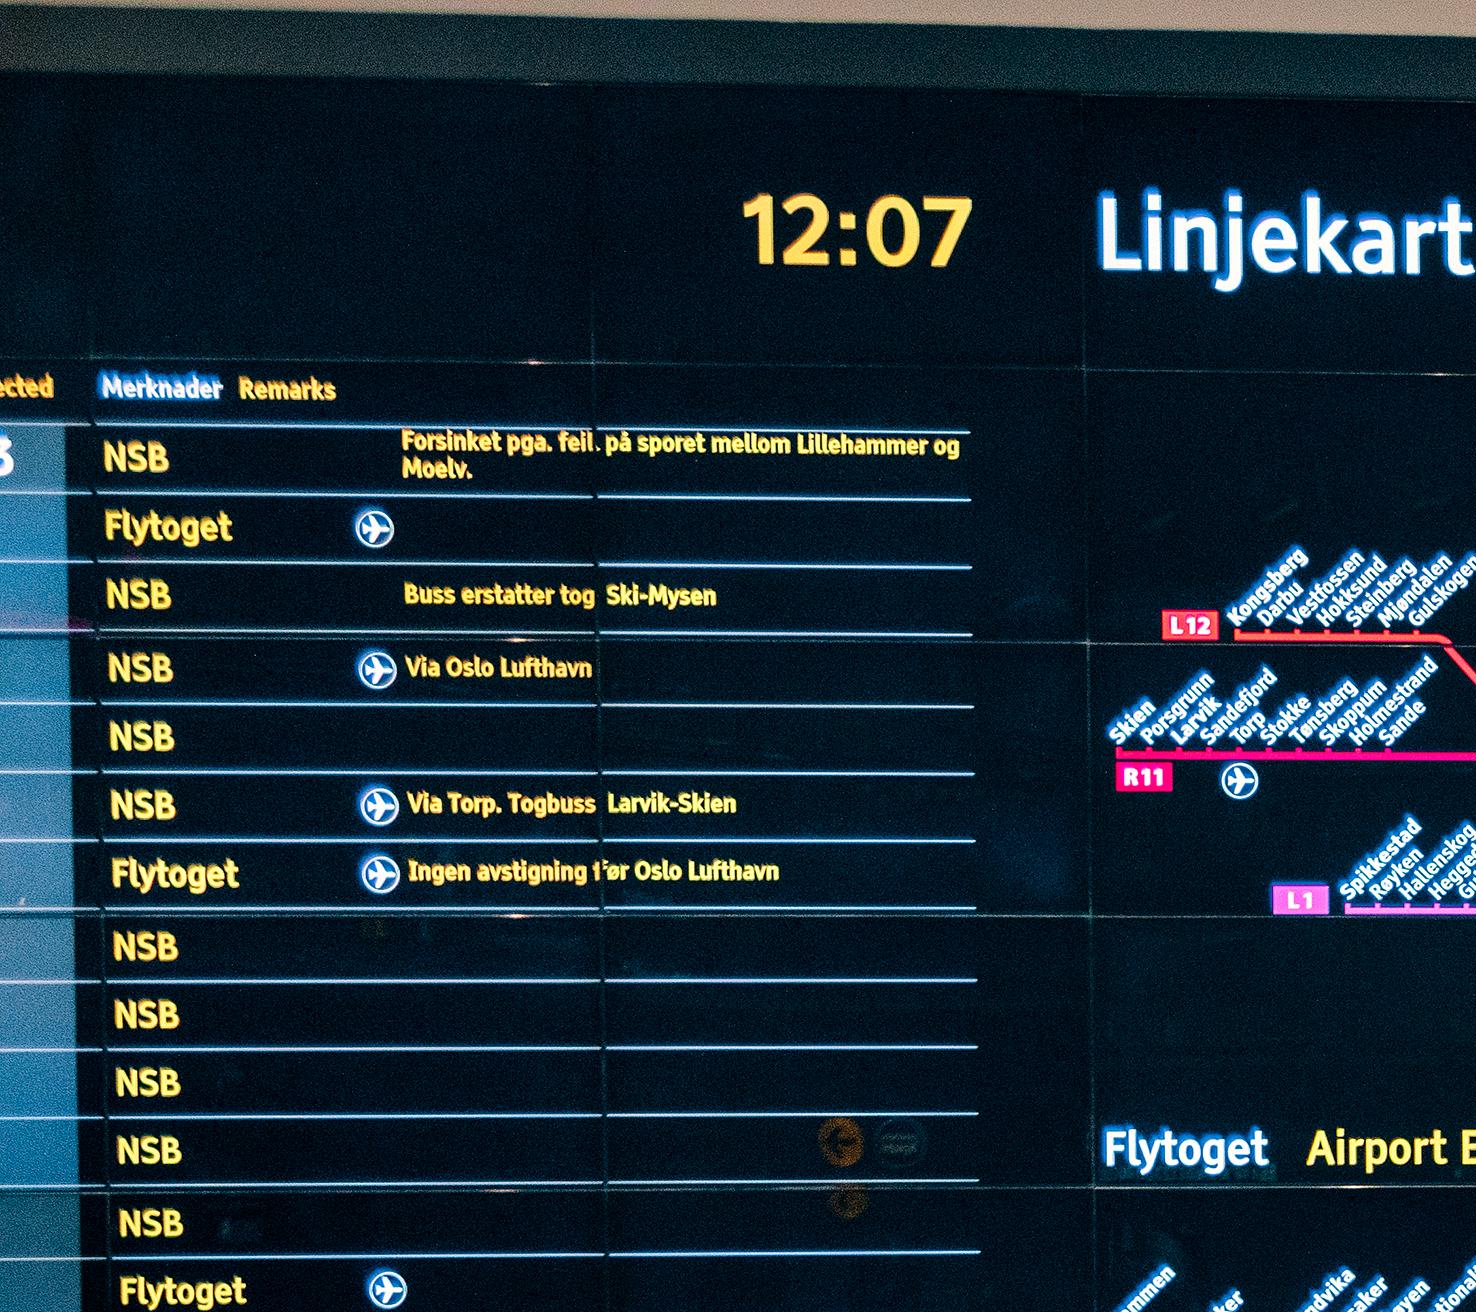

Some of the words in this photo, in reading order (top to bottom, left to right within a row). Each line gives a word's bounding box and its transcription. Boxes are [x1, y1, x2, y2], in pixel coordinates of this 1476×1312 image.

[744, 194, 972, 267] 12:07
[1102, 191, 1475, 292] Linjekart
[102, 374, 223, 399] Merknader
[239, 377, 336, 400] Remarks
[104, 441, 169, 472] NSB
[401, 429, 502, 452] Forsinket
[506, 433, 554, 457] pga.
[605, 431, 632, 456] på
[636, 432, 706, 457] sporet
[711, 433, 792, 455] mellom
[796, 432, 929, 455] Lillehammer
[933, 438, 960, 460] og
[402, 456, 472, 479] Moelv.
[106, 509, 232, 547] Flytoget
[107, 579, 171, 609] NSB
[405, 583, 455, 604] Buss
[461, 584, 555, 605] erstatter
[560, 585, 595, 609] tog
[607, 583, 716, 609] Ski-Mysen
[1227, 550, 1308, 626] Kongsberg
[1286, 553, 1364, 624] Vestfossen
[1316, 556, 1387, 626] Hokksund
[1378, 556, 1452, 627] Mjøndalen
[405, 656, 440, 677] Via
[446, 656, 494, 677] Oslo
[501, 656, 592, 677] Lufthavn
[1200, 668, 1277, 744] Sandefjord
[1289, 681, 1358, 743] Tønsberg
[1349, 656, 1438, 745] Holmestrand
[407, 791, 442, 813] Via
[448, 792, 502, 818] Torp.
[508, 792, 596, 818] Togbuss
[608, 792, 736, 813] Larvik-Skien
[112, 857, 239, 894] Flytoget
[409, 860, 471, 885] Ingen
[477, 860, 587, 885] avstigning
[635, 859, 682, 880] Oslo
[689, 860, 779, 880] Lufthavn
[1106, 1129, 1269, 1175] Flytoget
[1307, 1128, 1447, 1173] Airport
